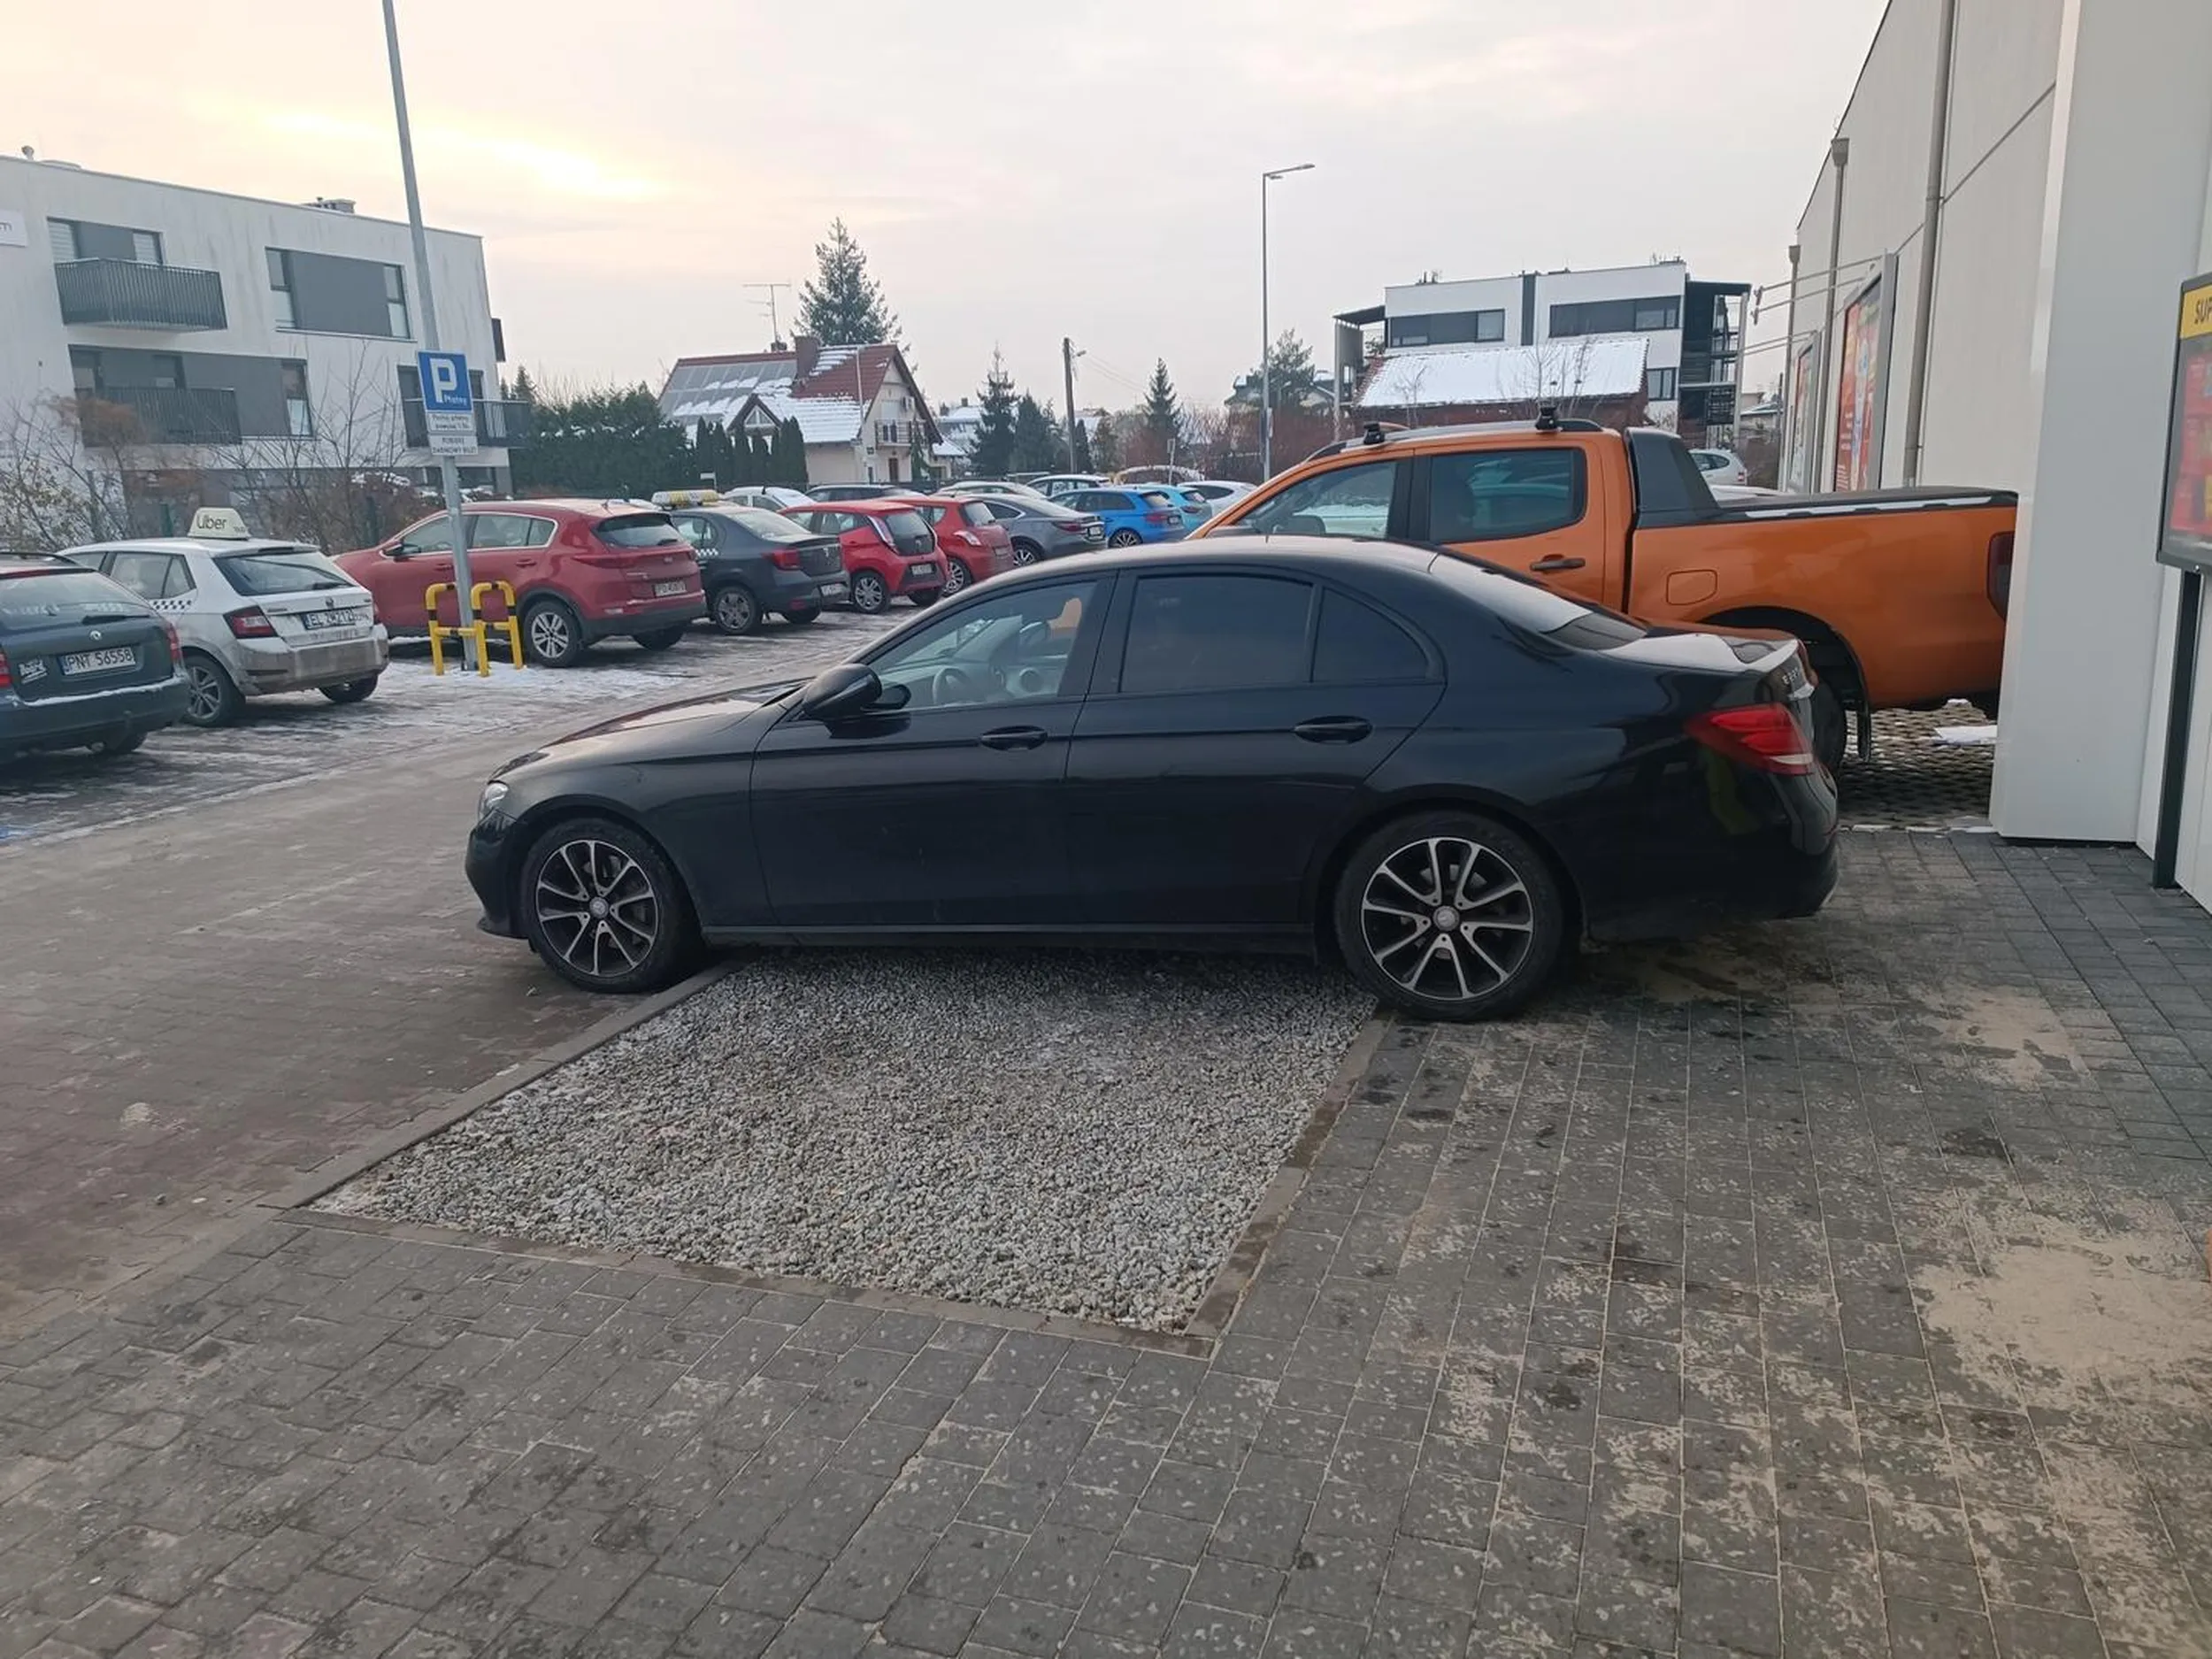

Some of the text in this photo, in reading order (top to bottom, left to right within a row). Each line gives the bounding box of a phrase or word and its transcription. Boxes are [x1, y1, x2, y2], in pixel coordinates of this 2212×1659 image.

[429, 358, 457, 403] P
[196, 514, 227, 529] Uber
[66, 649, 132, 670] PNT 56558
